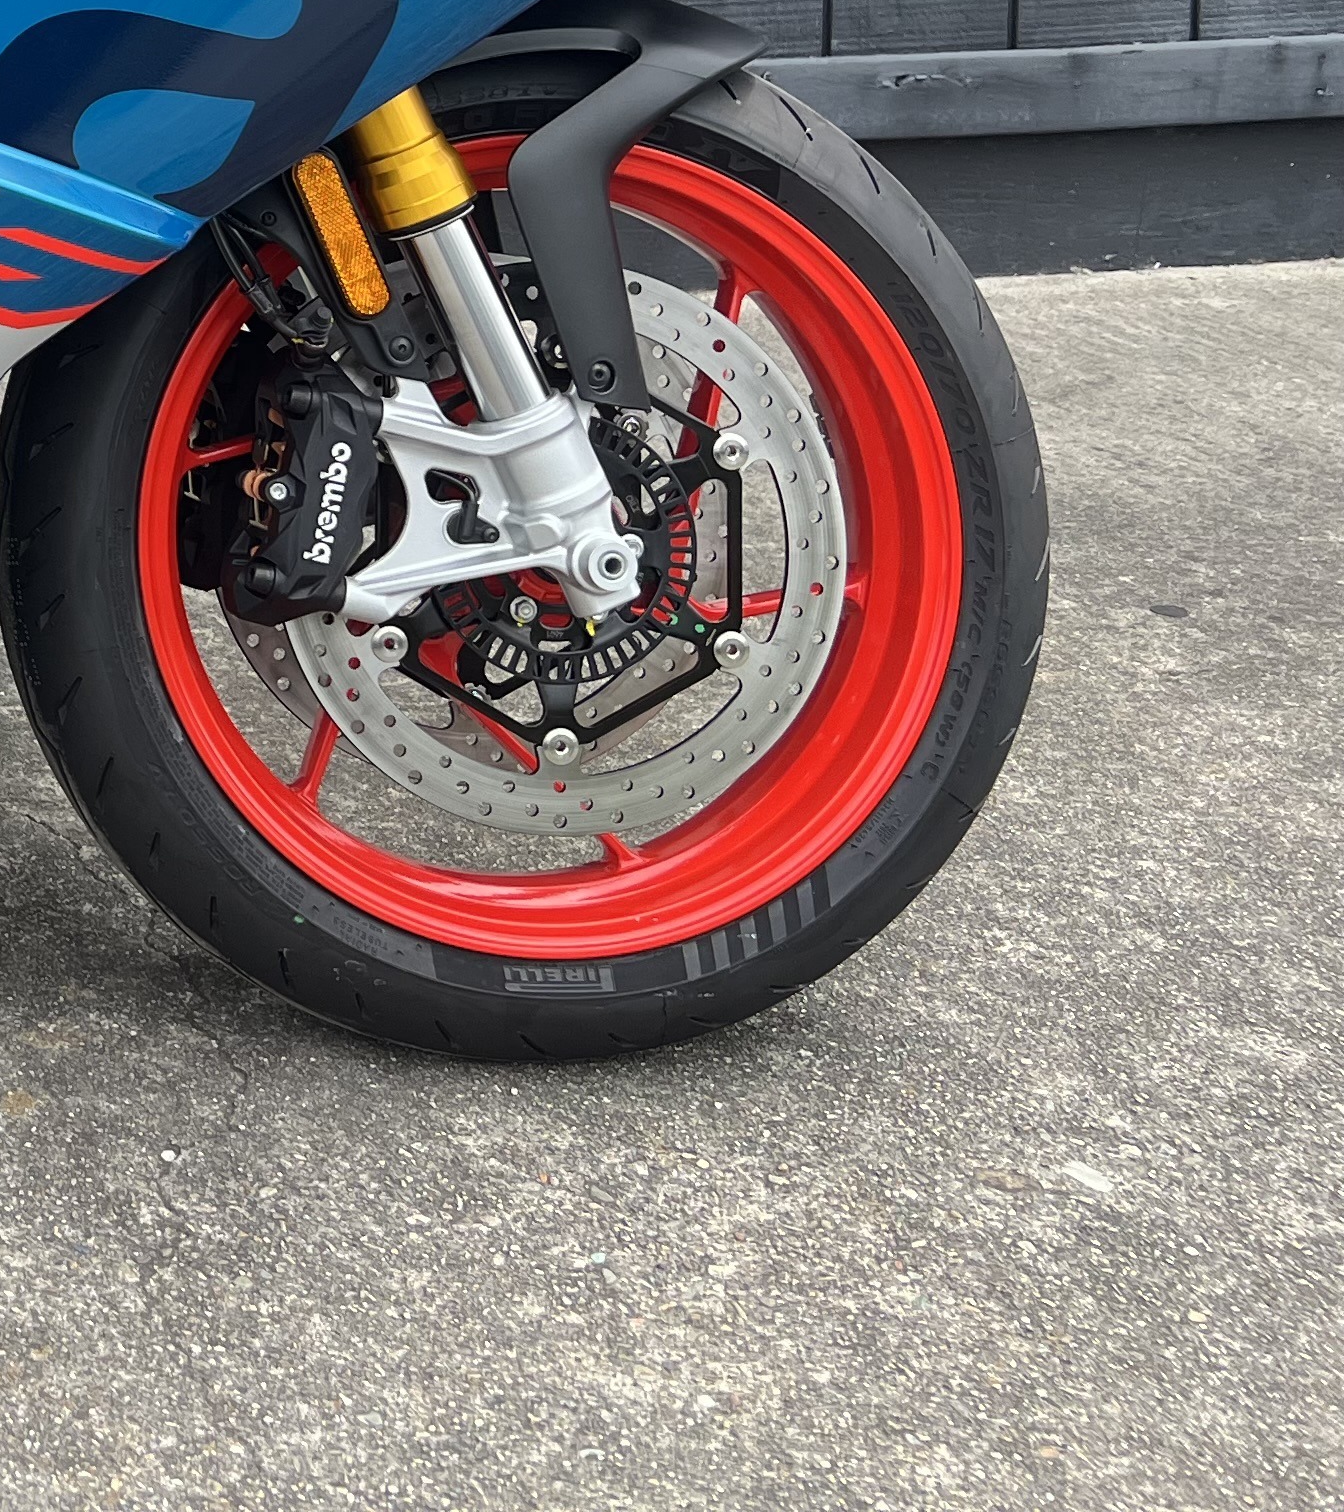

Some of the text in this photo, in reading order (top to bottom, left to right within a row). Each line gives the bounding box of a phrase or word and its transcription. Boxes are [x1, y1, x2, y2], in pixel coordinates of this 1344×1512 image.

[888, 286, 978, 439] 120/70
[302, 441, 353, 565] brembo
[503, 964, 617, 993] PIRELLI
